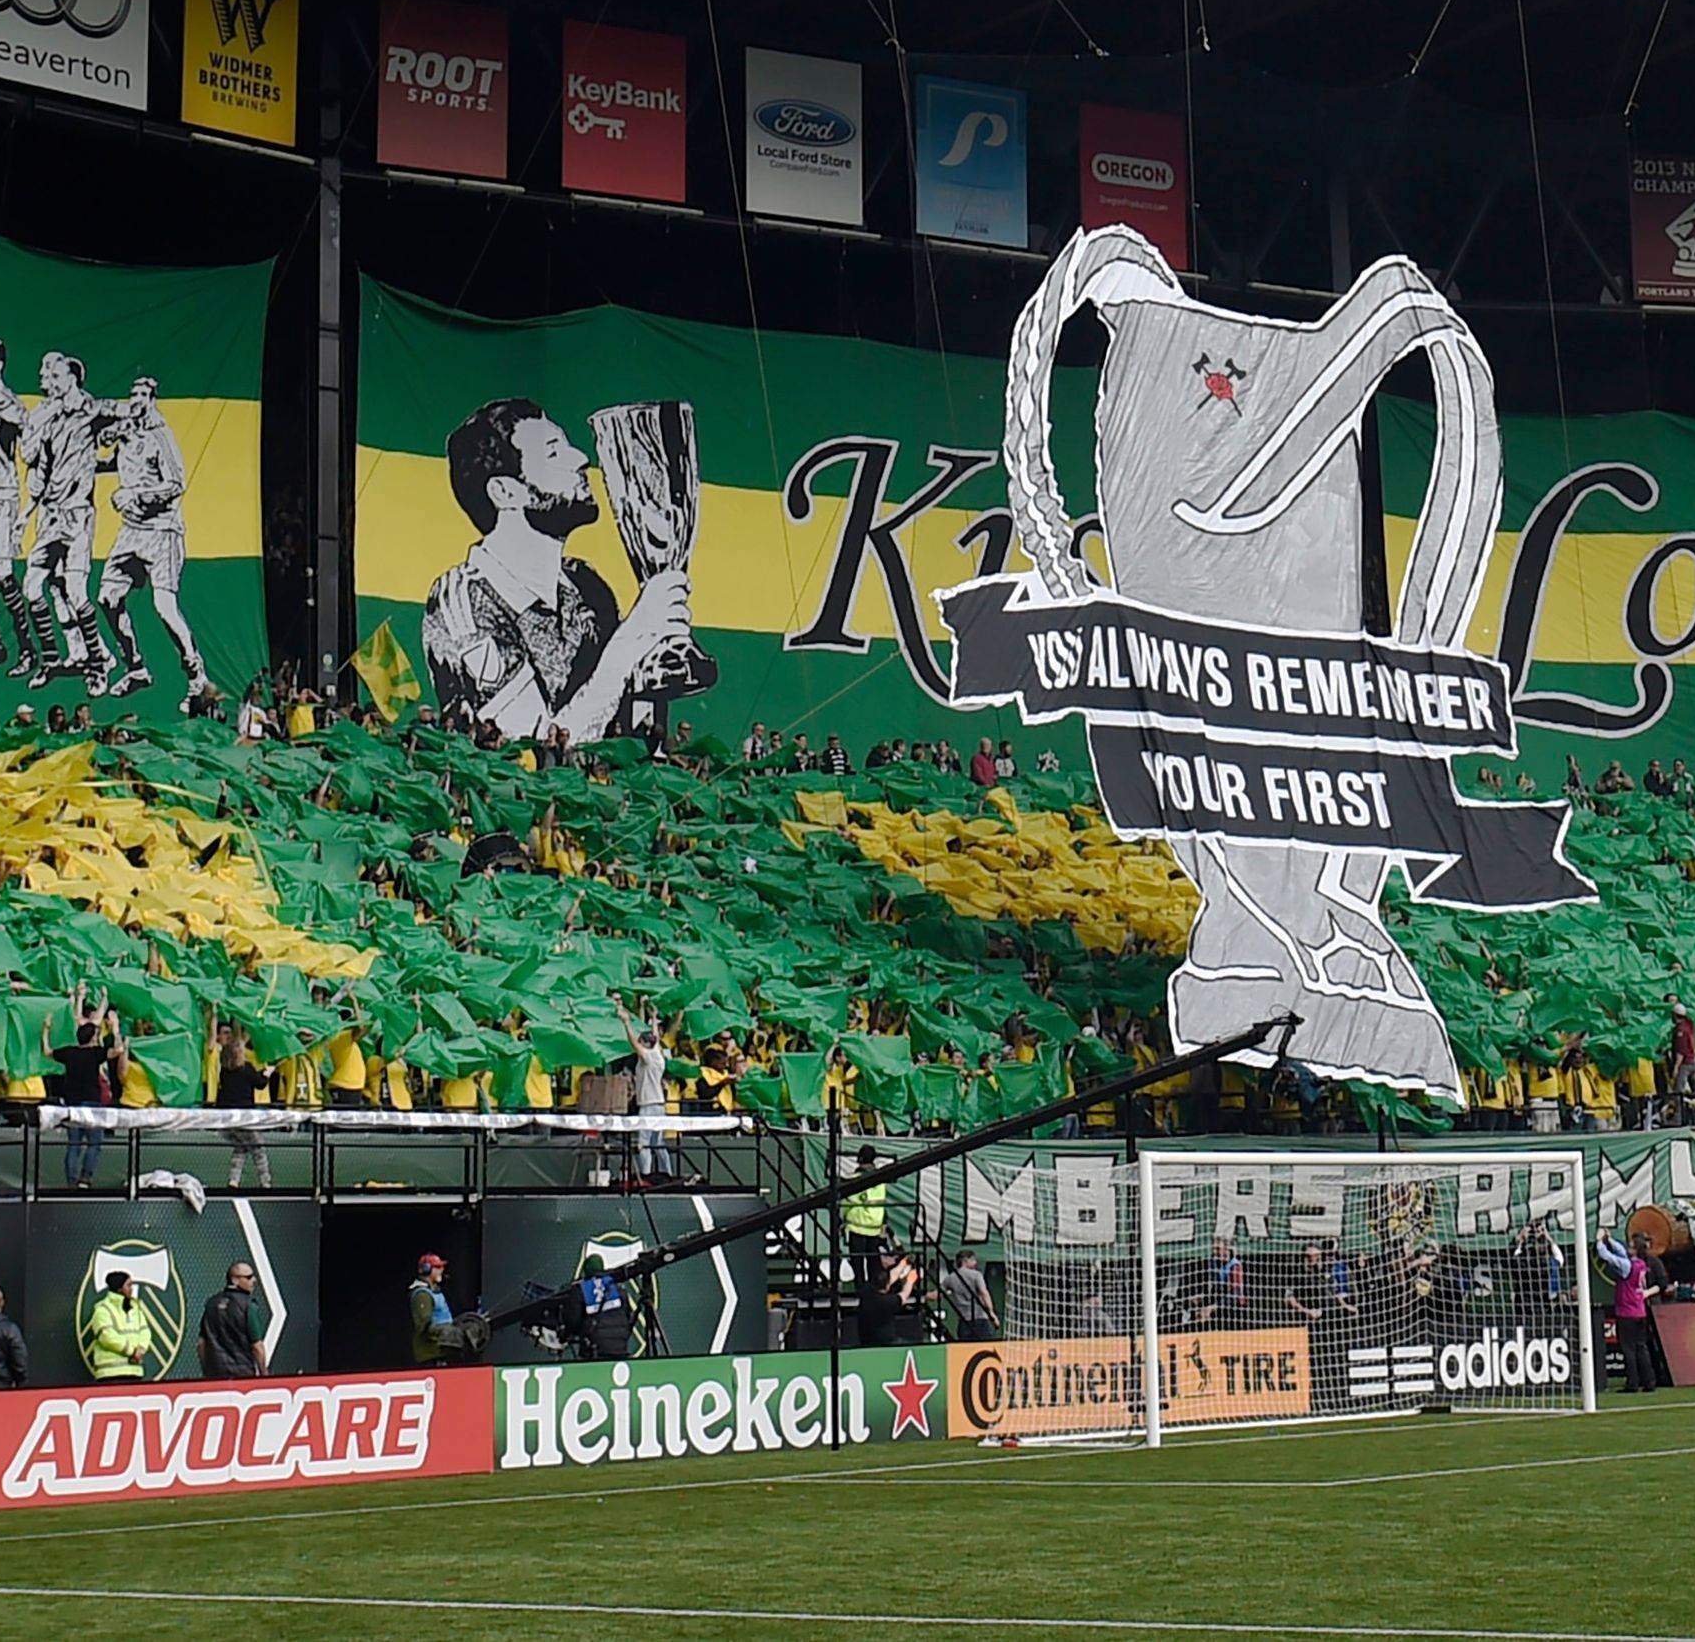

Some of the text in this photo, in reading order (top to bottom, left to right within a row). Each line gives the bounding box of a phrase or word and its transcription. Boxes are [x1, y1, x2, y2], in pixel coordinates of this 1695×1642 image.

[208, 50, 274, 83] WIDMER
[384, 45, 503, 96] ROOT
[198, 69, 283, 104] BROTHERS
[210, 90, 268, 114] BREWING
[407, 87, 489, 113] SPORTS
[567, 73, 682, 114] KeyBank
[771, 103, 837, 142] Ford
[758, 144, 852, 169] Local Ford Store
[1096, 160, 1167, 184] OREGON
[1633, 159, 1676, 179] 2013
[1637, 286, 1689, 299] PORTLAND
[1087, 628, 1232, 708] ALWAYS
[1245, 651, 1497, 732] REMEMBER
[1141, 749, 1391, 830] YOUR FIRST
[1219, 1350, 1297, 1396] TIRE
[1438, 1325, 1572, 1392] adidas
[499, 1357, 870, 1470] Heineken
[11, 1392, 425, 1484] ADVOCARE
